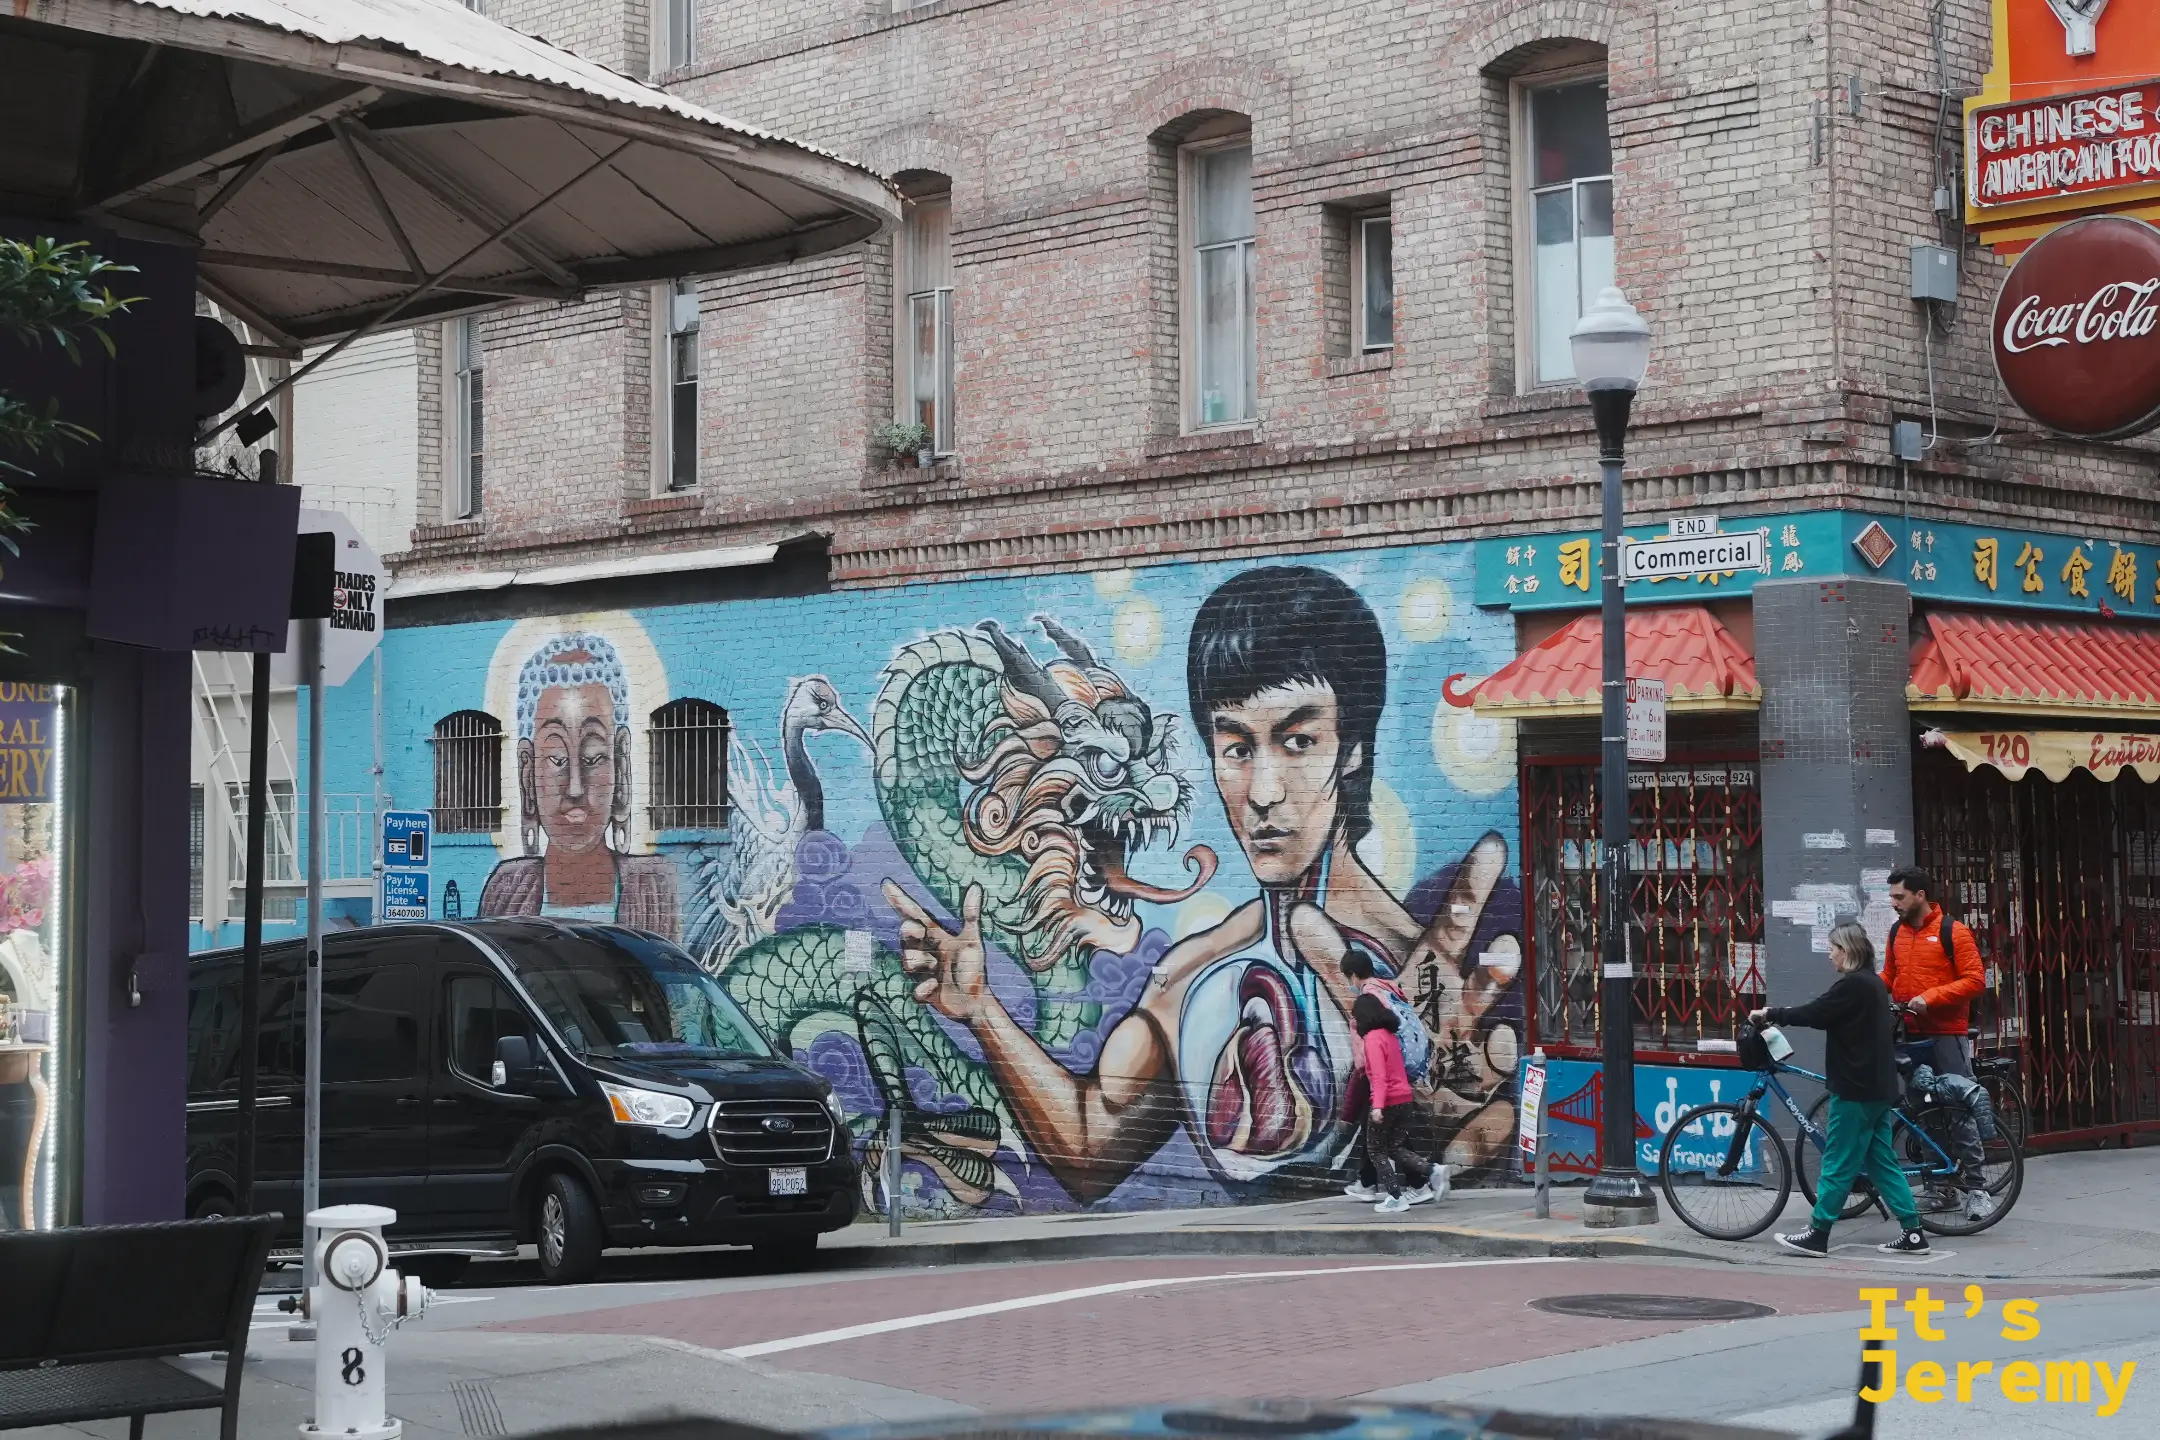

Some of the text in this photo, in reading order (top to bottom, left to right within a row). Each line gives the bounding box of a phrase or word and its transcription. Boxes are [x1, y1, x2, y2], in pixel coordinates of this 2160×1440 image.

[1980, 92, 2145, 153] CHINESE
[1982, 142, 2115, 197] AMERICAN
[2003, 277, 2160, 353] Coca-Cola
[1677, 519, 1706, 534] END
[1634, 540, 1751, 570] Commercial
[329, 609, 376, 632] REMAND
[1637, 686, 1664, 703] PARKING
[1646, 729, 1662, 743] THUR
[1627, 747, 1663, 757] STREET CLEANING
[1979, 734, 2030, 768] 720
[1628, 773, 1655, 784] stern
[1659, 773, 1686, 784] akery
[1730, 771, 1751, 783] 924
[386, 817, 428, 830] Pay here
[386, 874, 416, 887] Pay by
[386, 886, 419, 895] License
[386, 895, 409, 905] Plate
[387, 908, 425, 918] 36407003
[1786, 1096, 1815, 1134] beyond
[1641, 1143, 1672, 1165] Sa
[1674, 1144, 1753, 1169] Francis
[341, 1347, 366, 1387] 8
